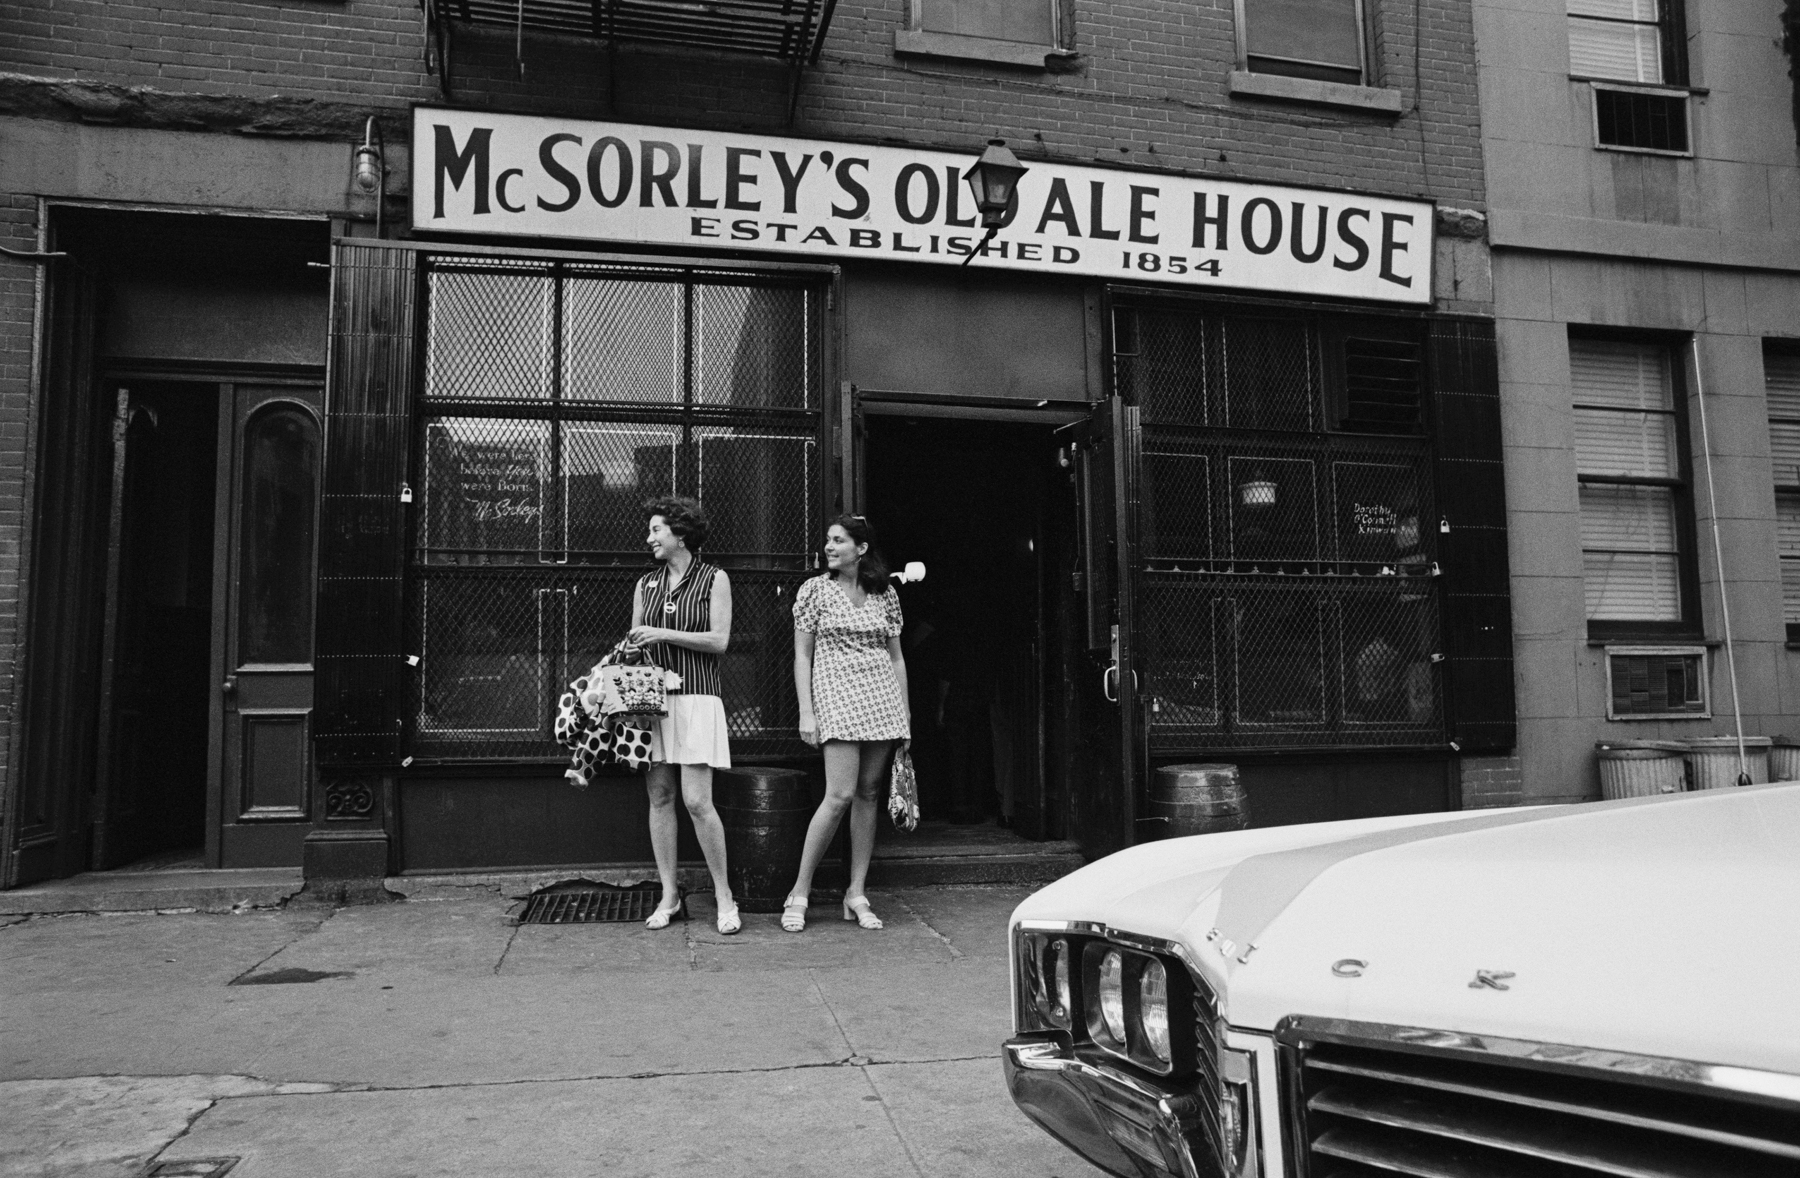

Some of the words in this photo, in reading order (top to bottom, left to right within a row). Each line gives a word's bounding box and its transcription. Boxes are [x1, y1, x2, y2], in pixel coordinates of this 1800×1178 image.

[433, 124, 870, 219] McSORLEY'S
[895, 162, 1019, 230] OL
[1035, 177, 1160, 245] ALE
[1191, 191, 1414, 288] HOUSE
[690, 216, 1080, 264] ESTABLISHED
[1122, 251, 1223, 277] 1854
[460, 482, 492, 492] were
